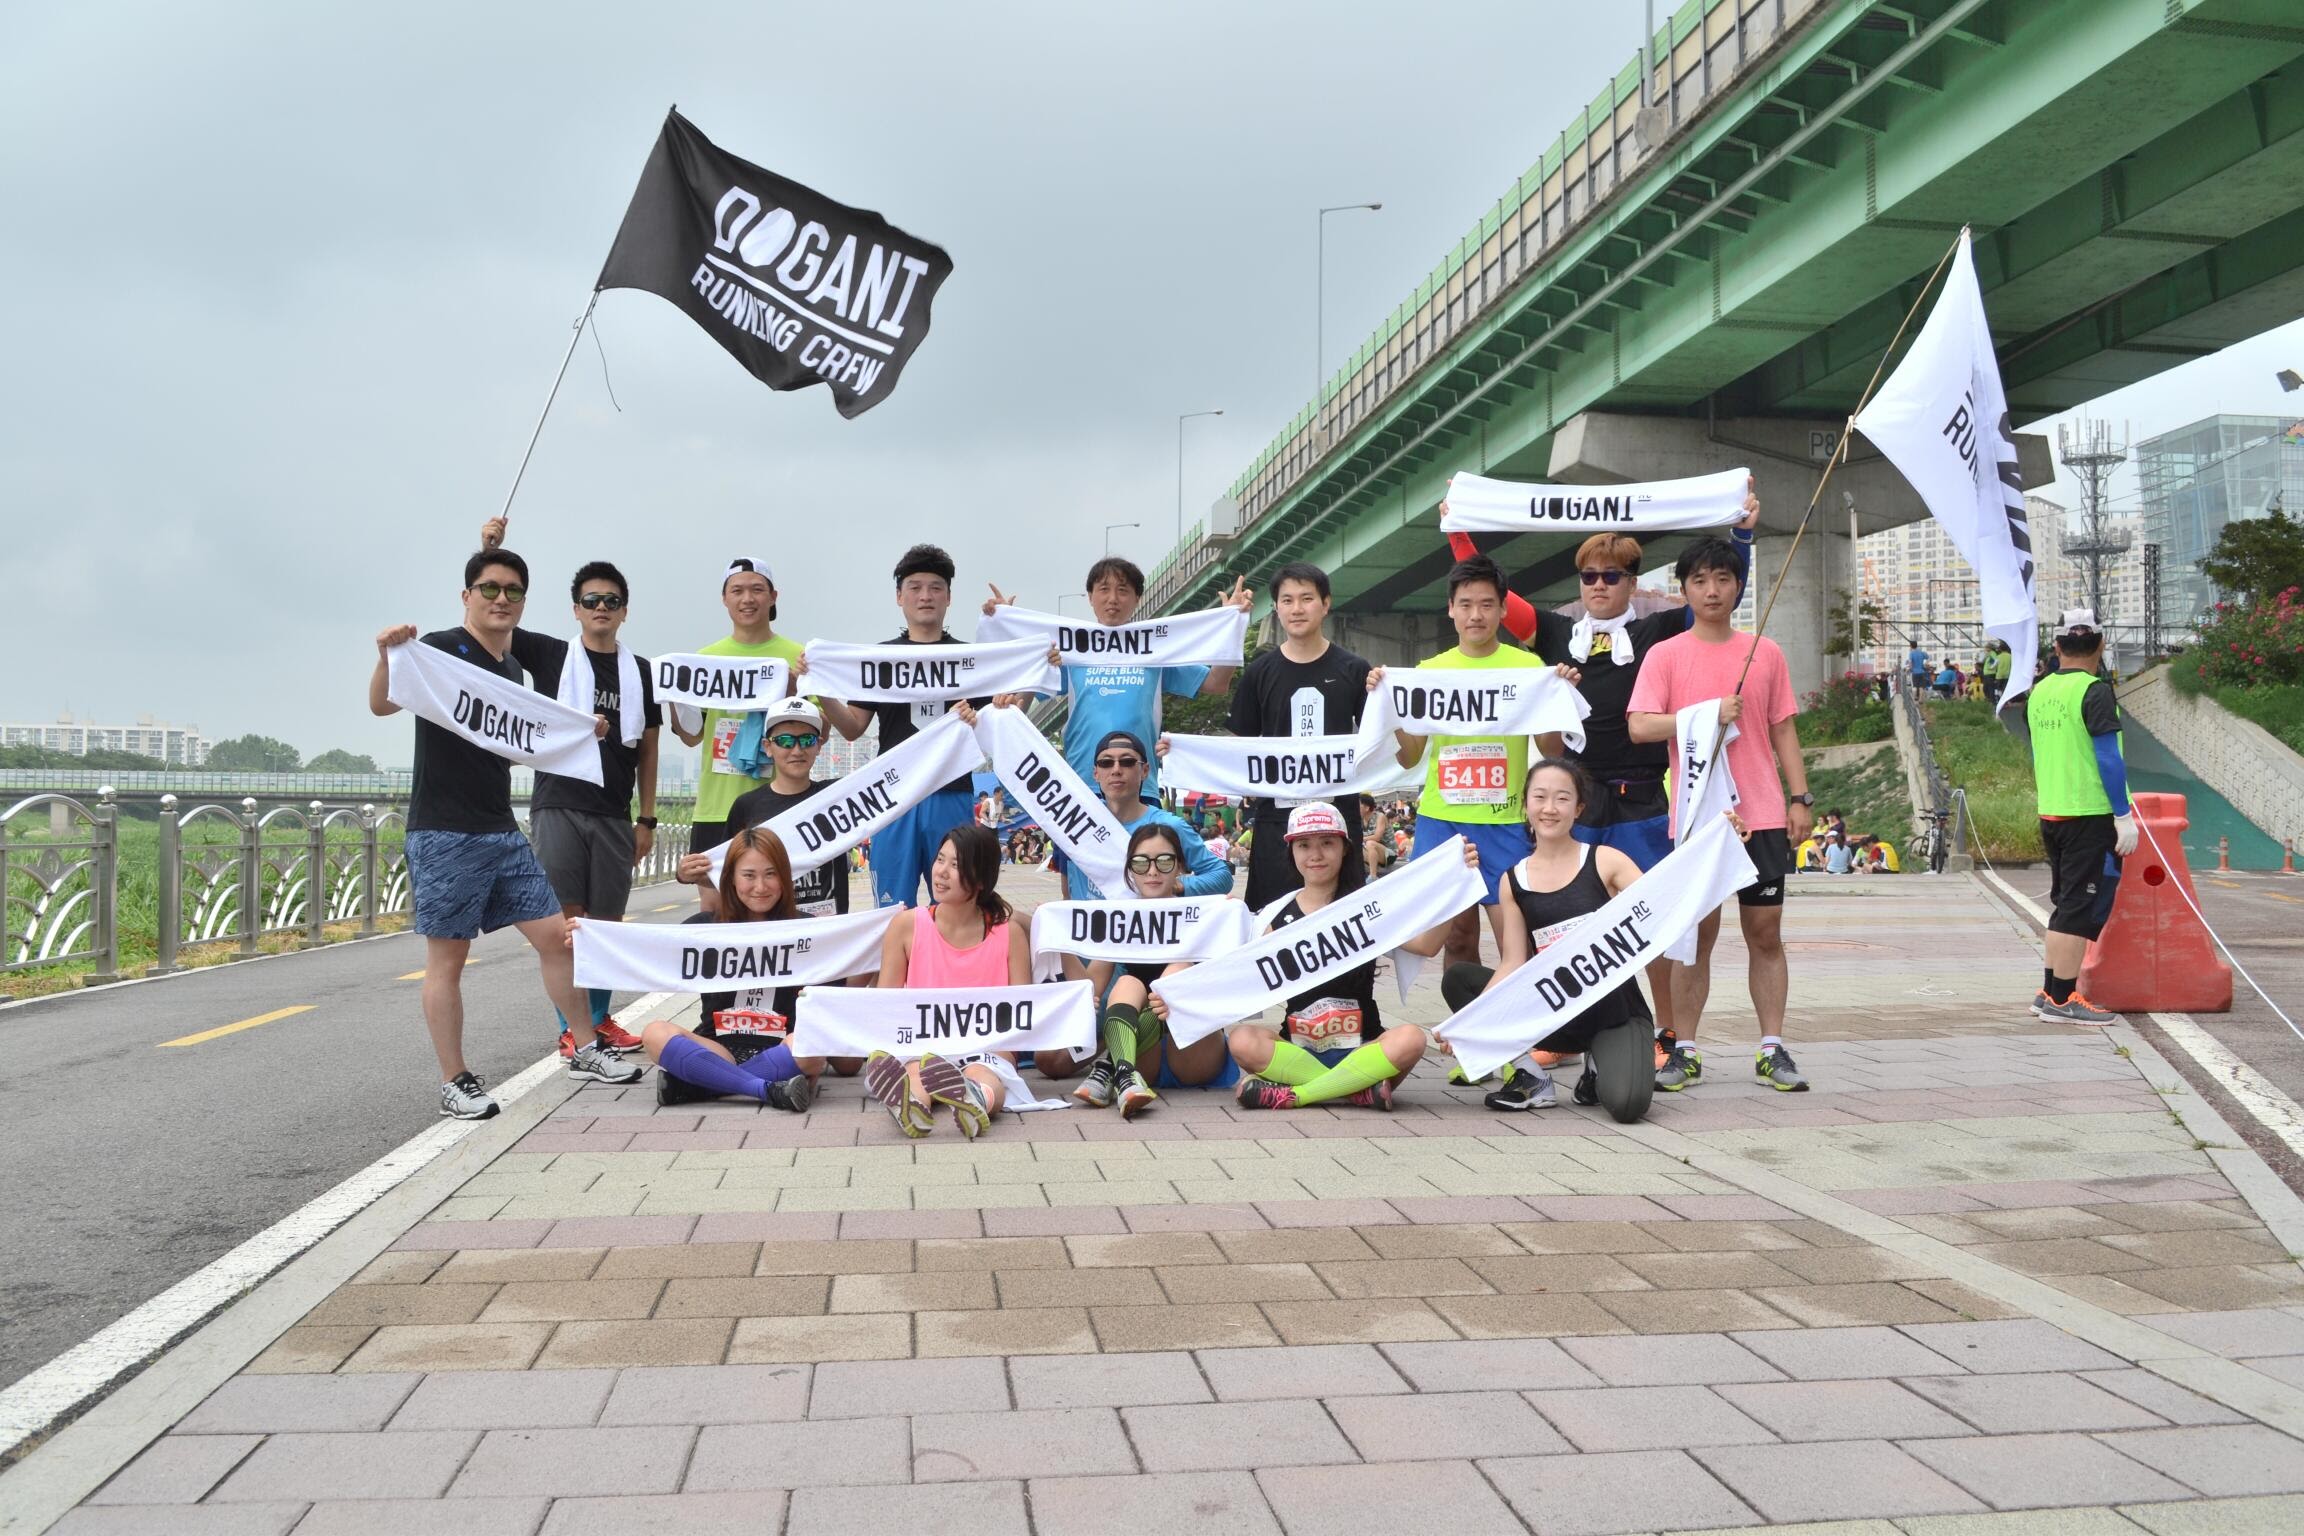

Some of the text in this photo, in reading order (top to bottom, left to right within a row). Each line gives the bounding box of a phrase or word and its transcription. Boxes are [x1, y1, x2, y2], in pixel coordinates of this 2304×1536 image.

[713, 185, 929, 339] DOGANI
[691, 263, 803, 352] RUNNING
[1811, 432, 1836, 457] P8
[1059, 627, 1154, 655] DOGANI
[660, 662, 759, 699] DOGANI
[861, 661, 960, 689] DOGANI
[1085, 676, 1145, 687] MARATHON
[1086, 667, 1145, 676] SUPER BLUE
[594, 689, 620, 711] GAN
[1302, 704, 1313, 716] DO
[1393, 685, 1500, 722] DOGANI
[453, 689, 535, 755] DOGANI
[1301, 718, 1314, 730] GA
[1248, 754, 1346, 784] DOGANI
[1443, 765, 1505, 788] 5418
[795, 779, 898, 852] DOGANI
[1015, 752, 1097, 846] DOGANI
[1297, 815, 1332, 826] Supreme
[1072, 908, 1183, 945] DOGANI
[681, 944, 795, 980] DOGANI
[1256, 912, 1376, 991] DOGANI
[1534, 915, 1651, 1012] DOGANI
[916, 1001, 1033, 1039] DOGANI
[1295, 1015, 1358, 1037] 5466
